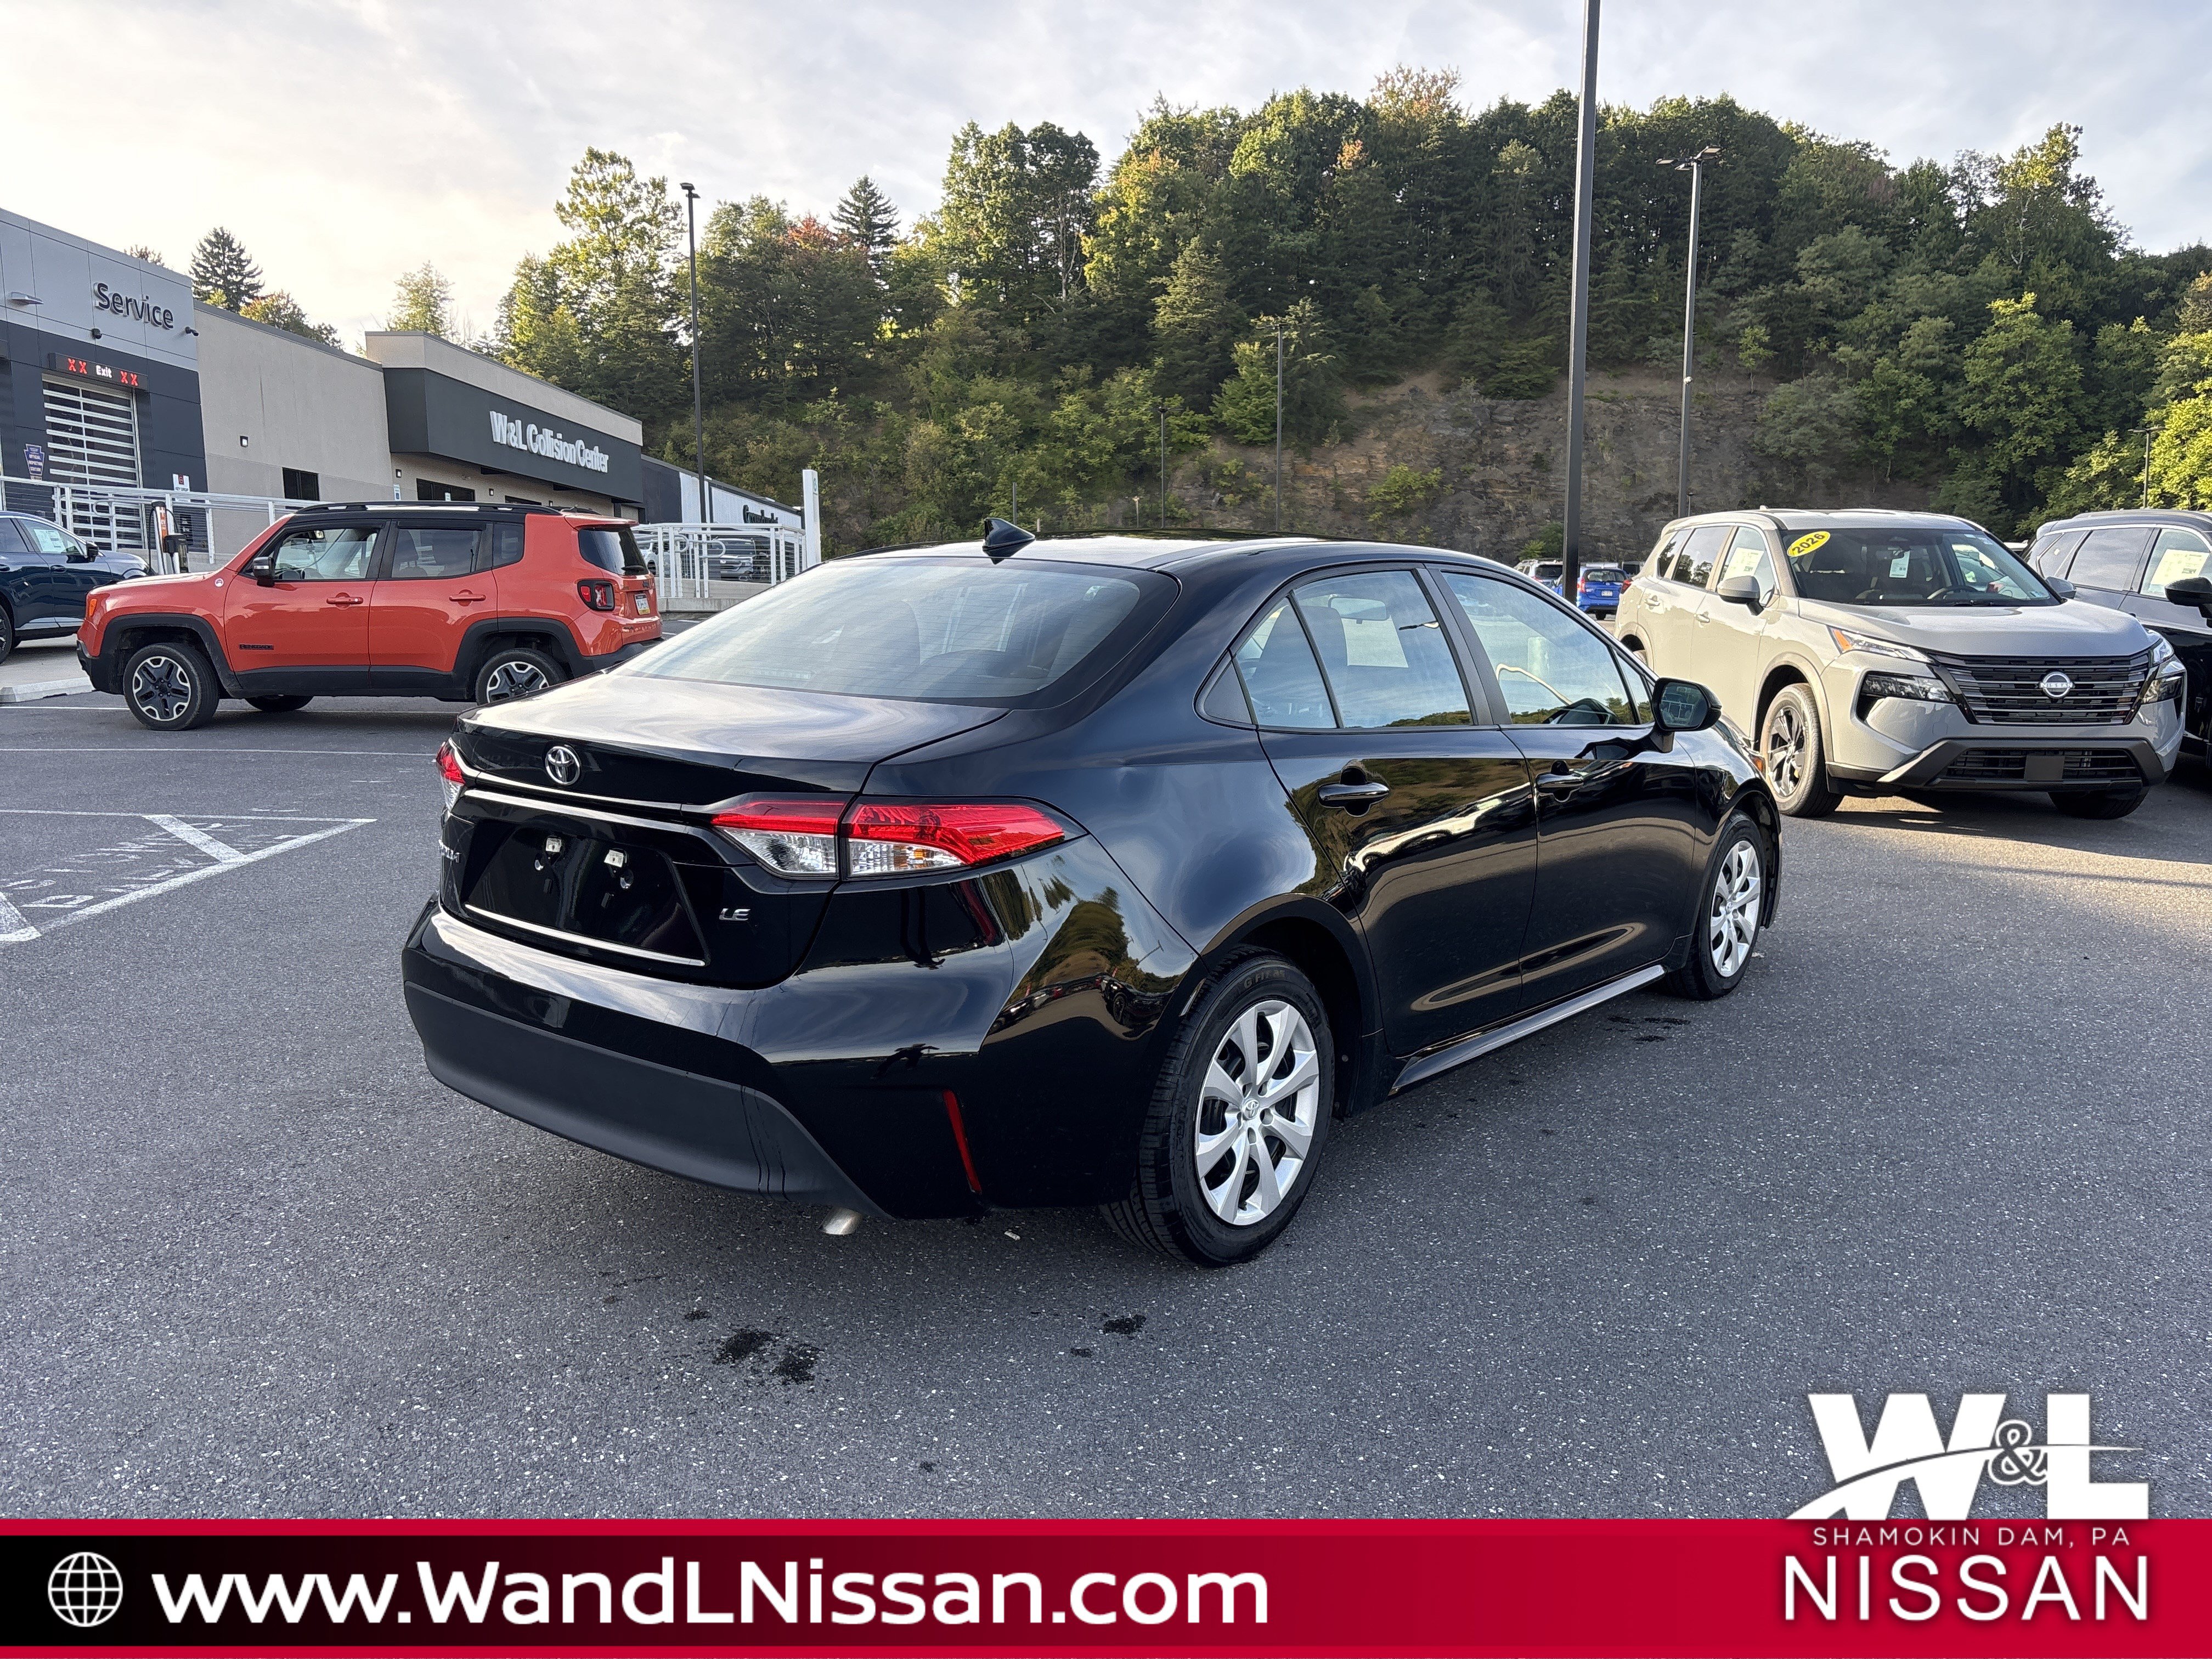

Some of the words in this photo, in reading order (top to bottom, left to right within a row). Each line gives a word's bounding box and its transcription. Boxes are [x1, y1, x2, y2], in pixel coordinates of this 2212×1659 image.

[95, 283, 174, 329] Service
[95, 365, 112, 378] Exit
[490, 411, 527, 450] W&L
[527, 424, 576, 465] Collision
[575, 439, 609, 473] Center
[1792, 533, 1825, 554] 2026
[719, 908, 751, 921] LE
